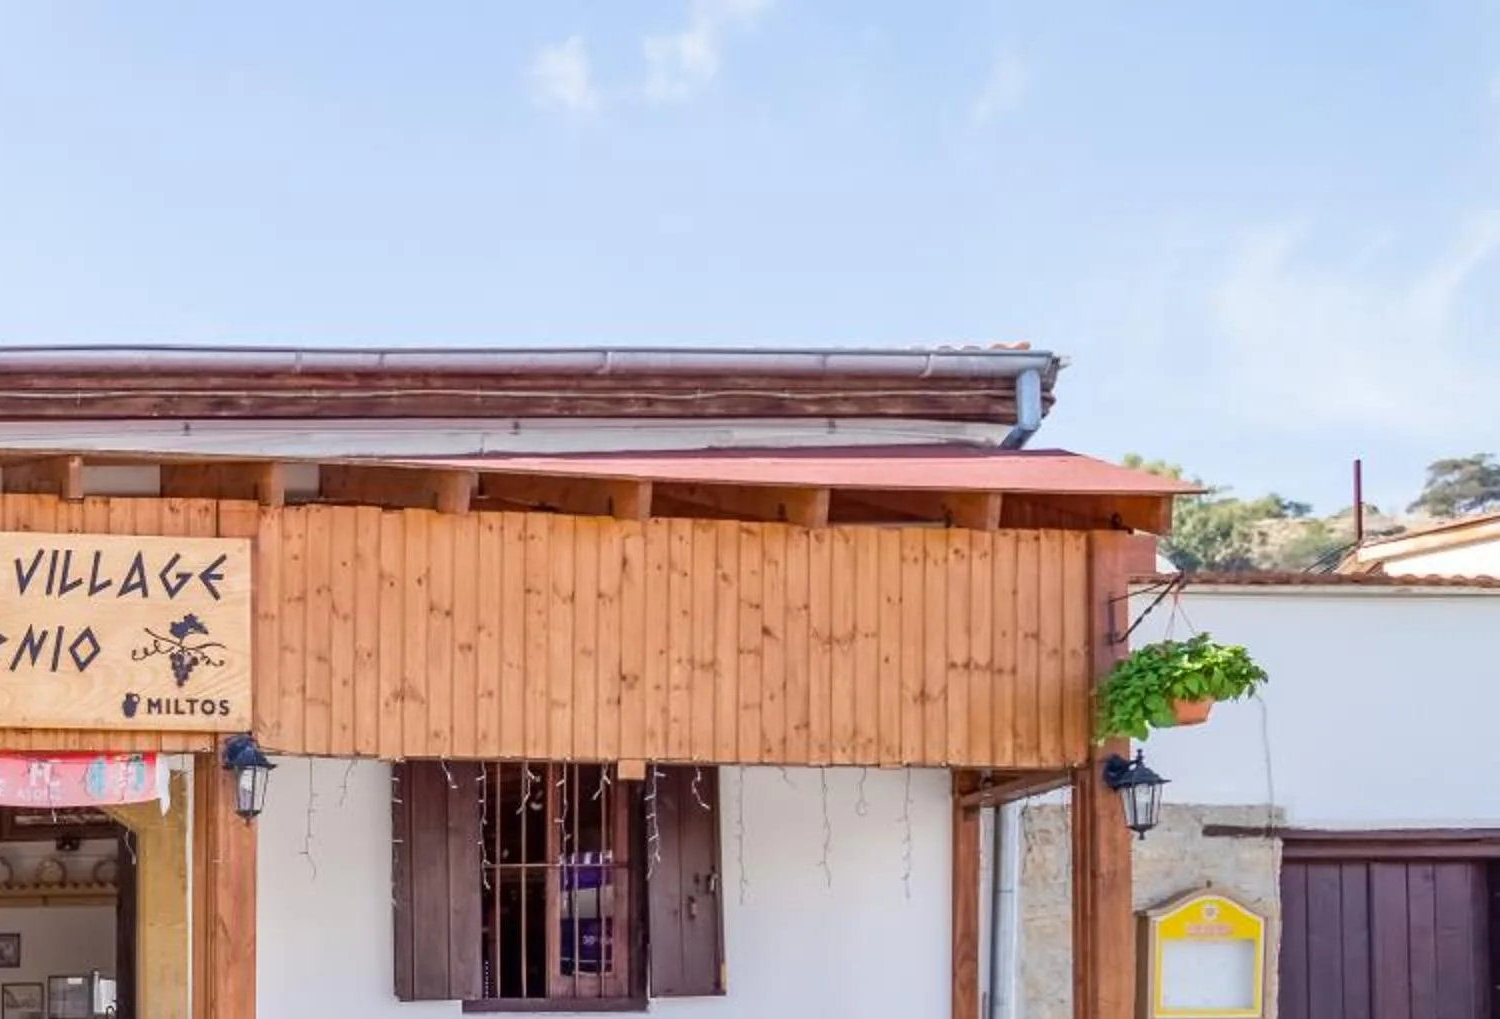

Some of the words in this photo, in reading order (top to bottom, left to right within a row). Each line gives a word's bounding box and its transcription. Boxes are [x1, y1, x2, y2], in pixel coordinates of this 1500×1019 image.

[15, 548, 228, 601] VILLAGE
[147, 698, 230, 716] MILTOS
[29, 761, 60, 787] FC
